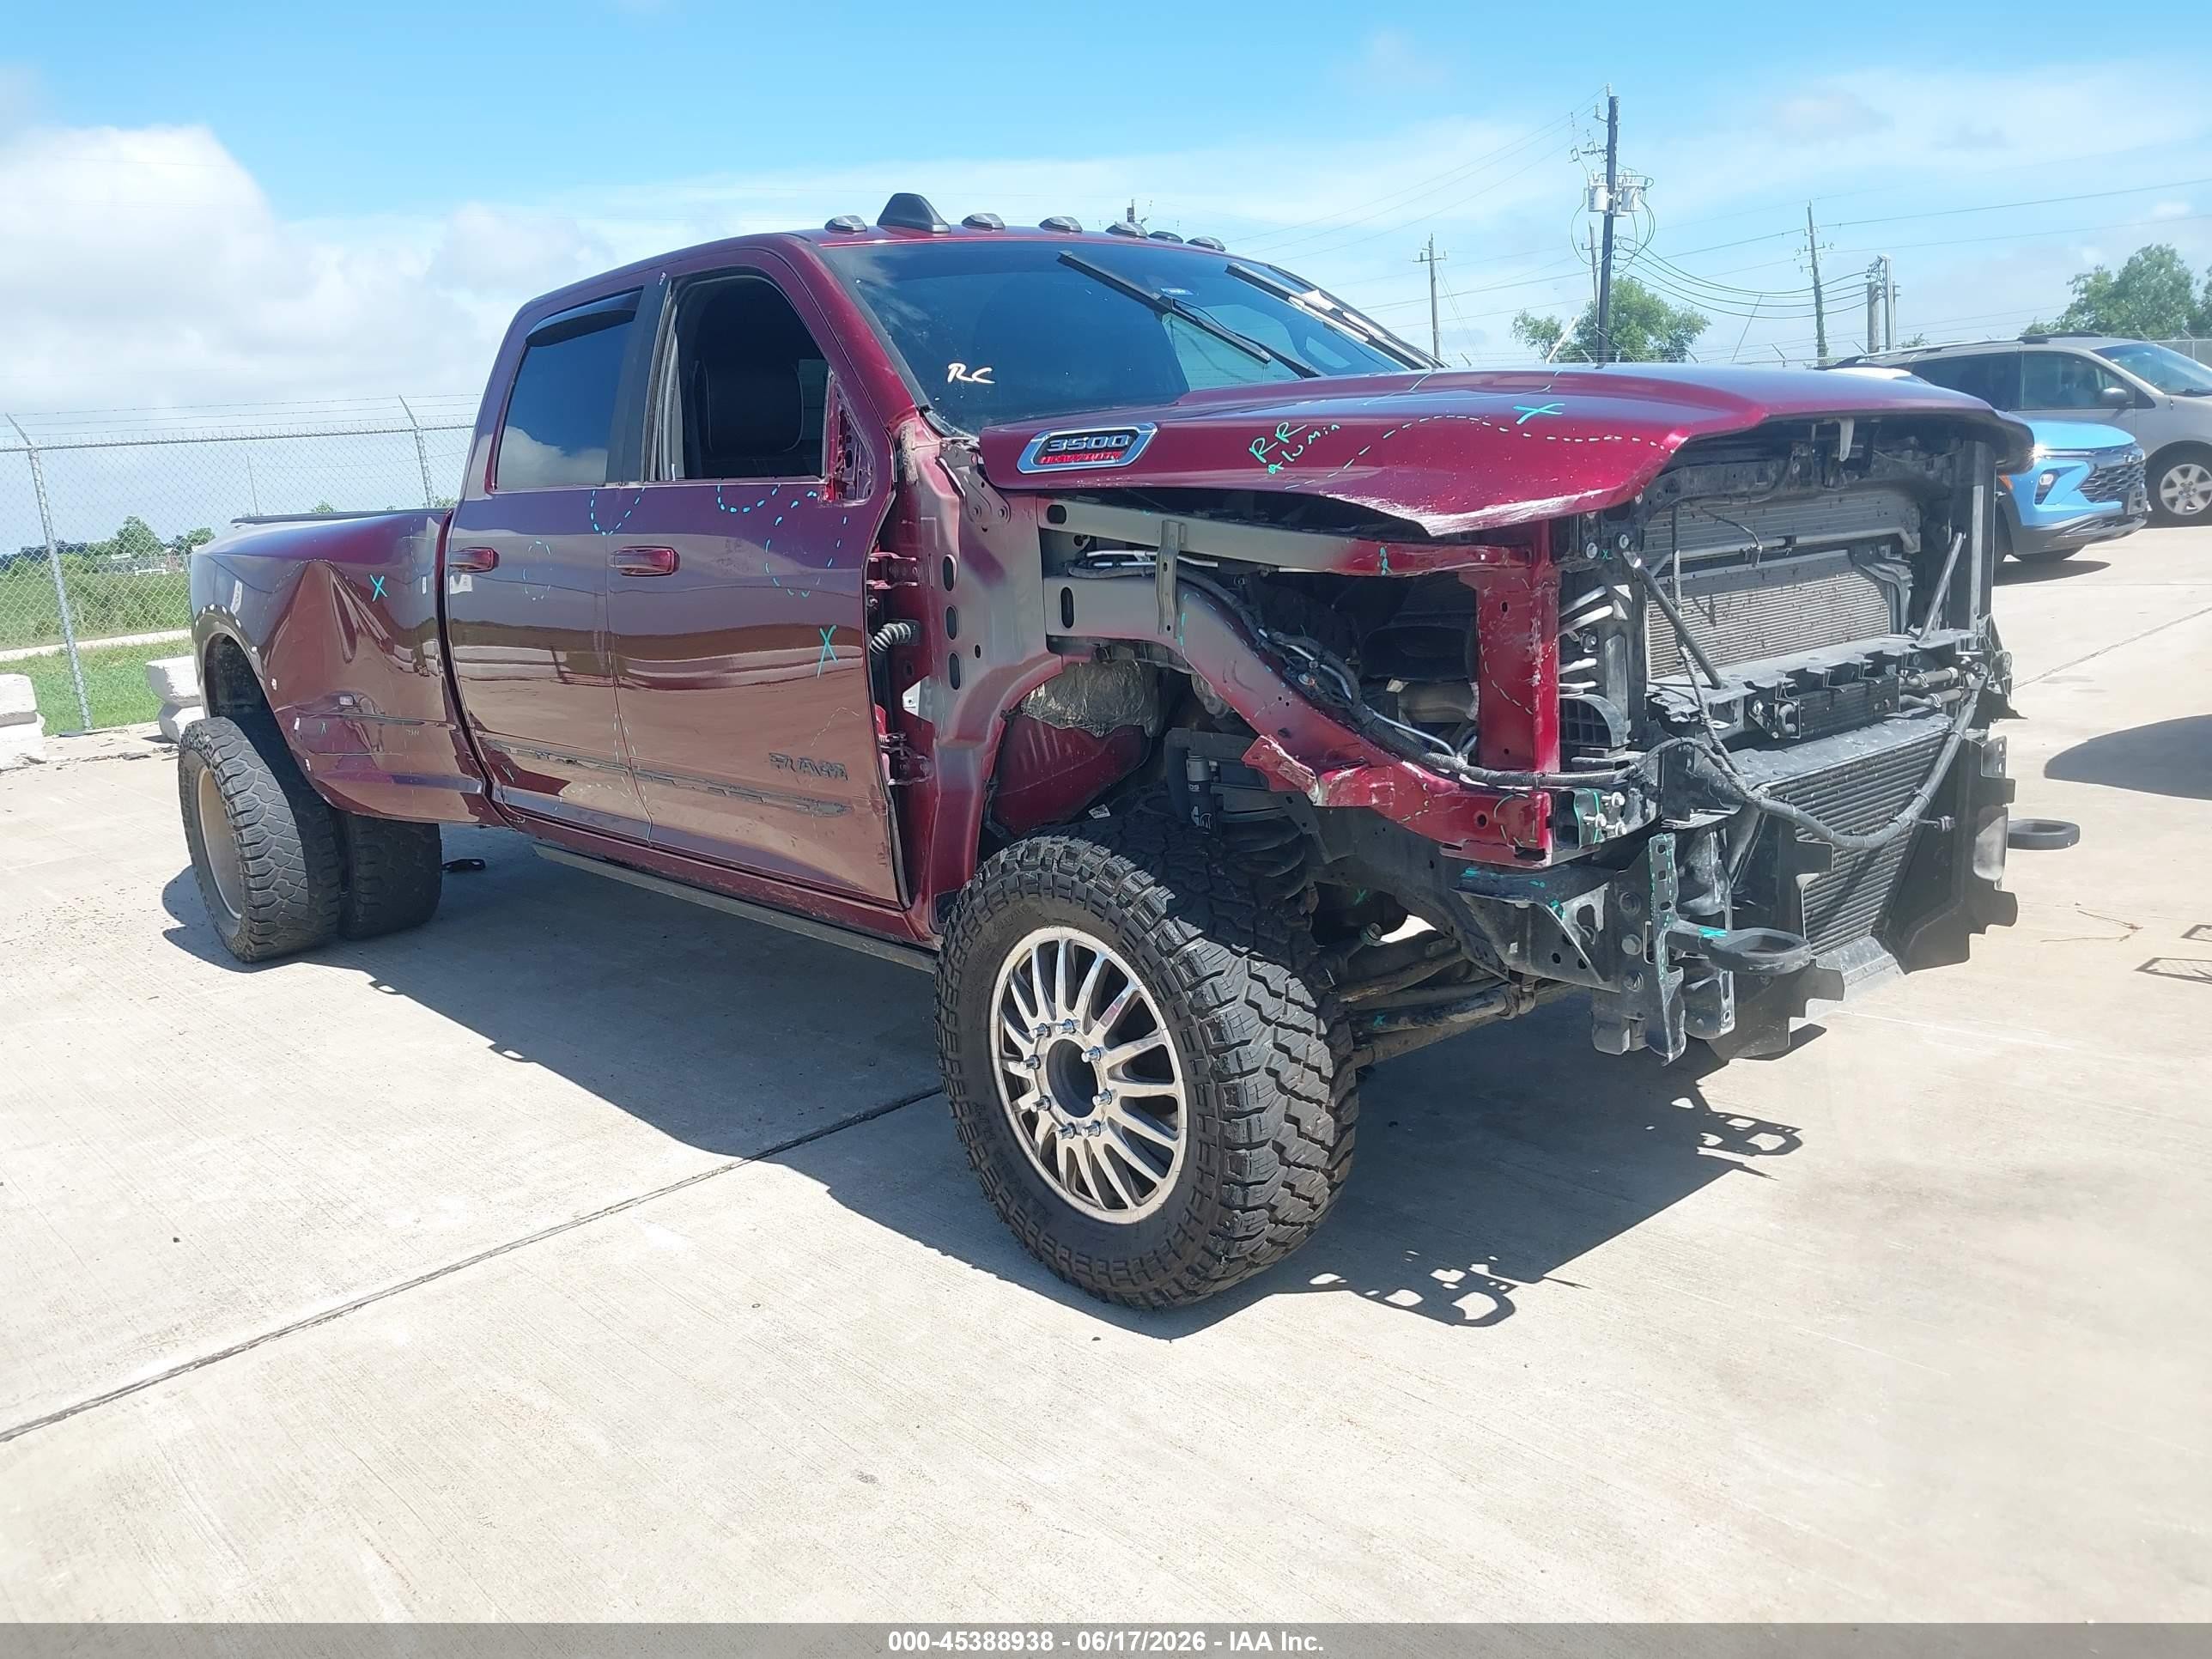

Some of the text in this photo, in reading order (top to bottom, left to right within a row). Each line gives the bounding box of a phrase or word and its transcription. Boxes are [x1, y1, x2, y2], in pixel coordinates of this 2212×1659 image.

[947, 362, 996, 384] RC
[1047, 434, 1131, 453] 3500
[1249, 422, 1308, 464] RR
[769, 751, 848, 782] RAM
